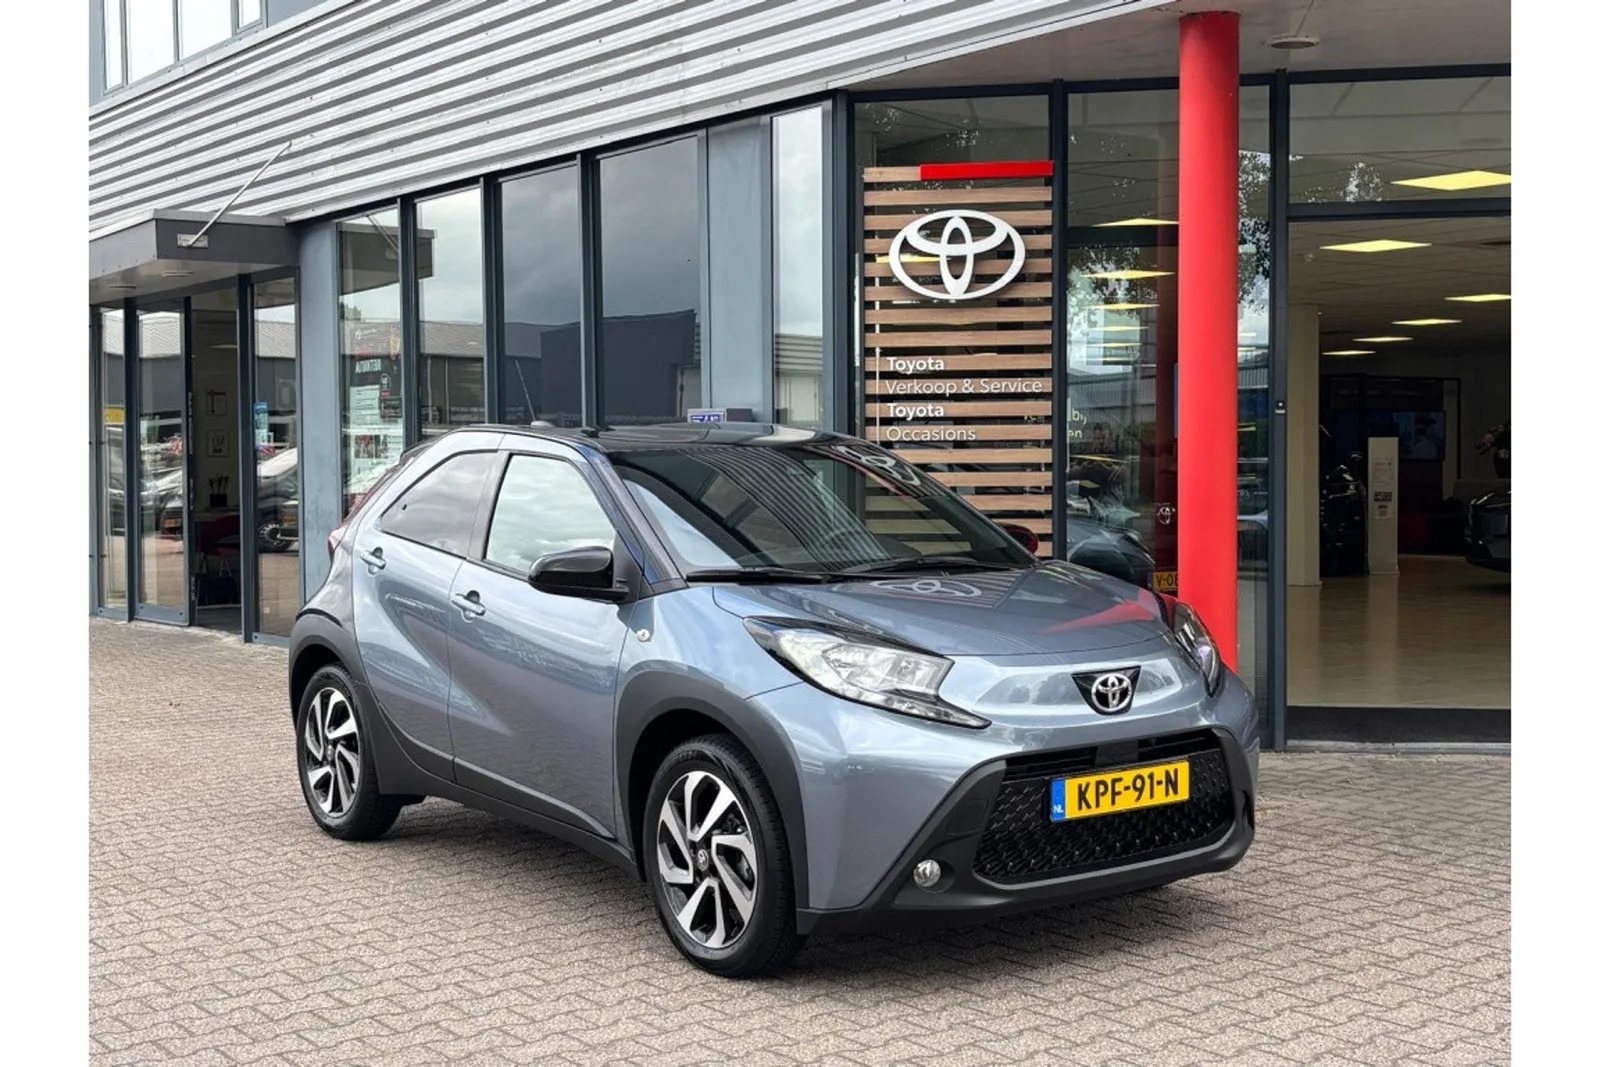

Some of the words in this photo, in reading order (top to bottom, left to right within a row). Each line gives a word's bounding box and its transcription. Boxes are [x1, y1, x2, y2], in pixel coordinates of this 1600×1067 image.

[887, 357, 945, 375] Toyota
[885, 379, 958, 396] Verkoop
[962, 380, 975, 393] &
[980, 378, 1043, 393] Service
[887, 403, 945, 421] Toyota
[886, 426, 977, 441] Occasions
[1077, 768, 1179, 811] KPF-91-N
[1053, 804, 1064, 814] NL
